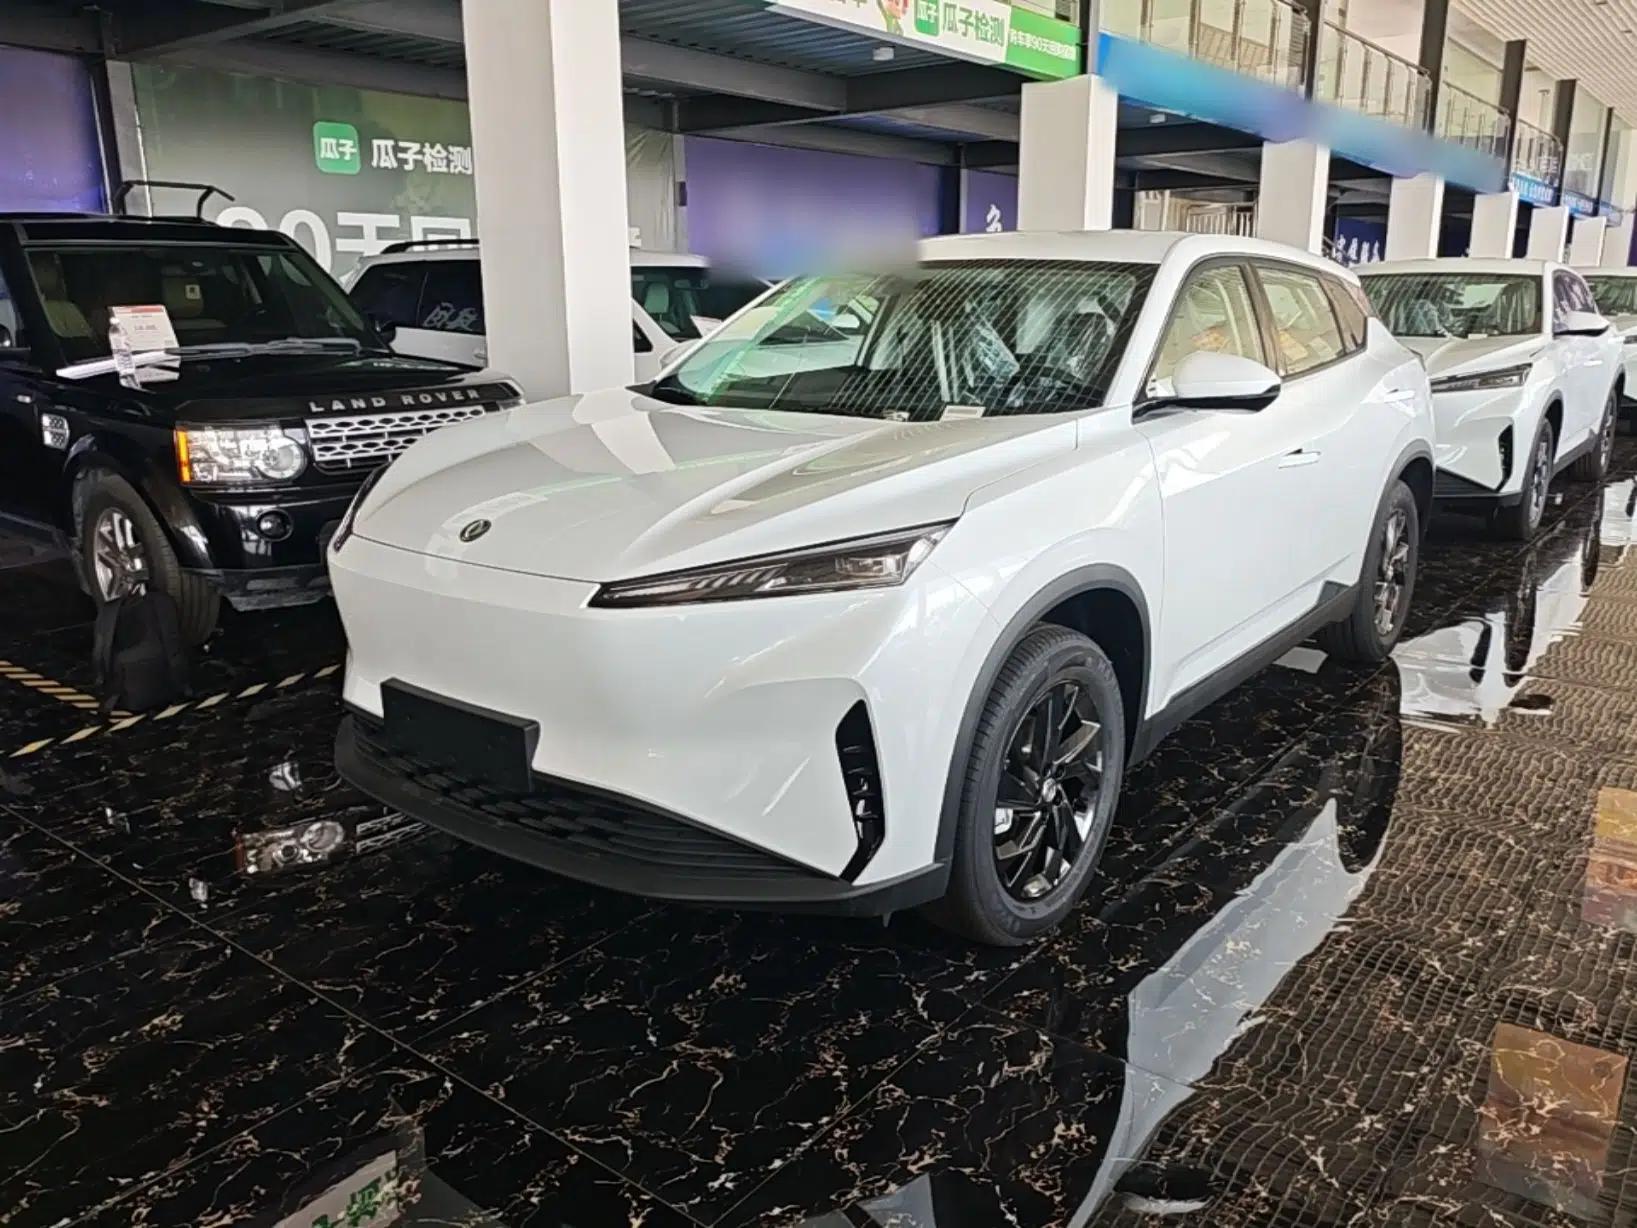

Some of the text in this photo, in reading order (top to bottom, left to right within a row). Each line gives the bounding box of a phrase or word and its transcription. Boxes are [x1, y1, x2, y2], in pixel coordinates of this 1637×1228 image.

[942, 3, 1005, 47] 瓜子检测
[320, 137, 358, 161] 瓜子
[371, 138, 472, 175] 瓜子检测
[309, 388, 480, 413] LAND ROVER
